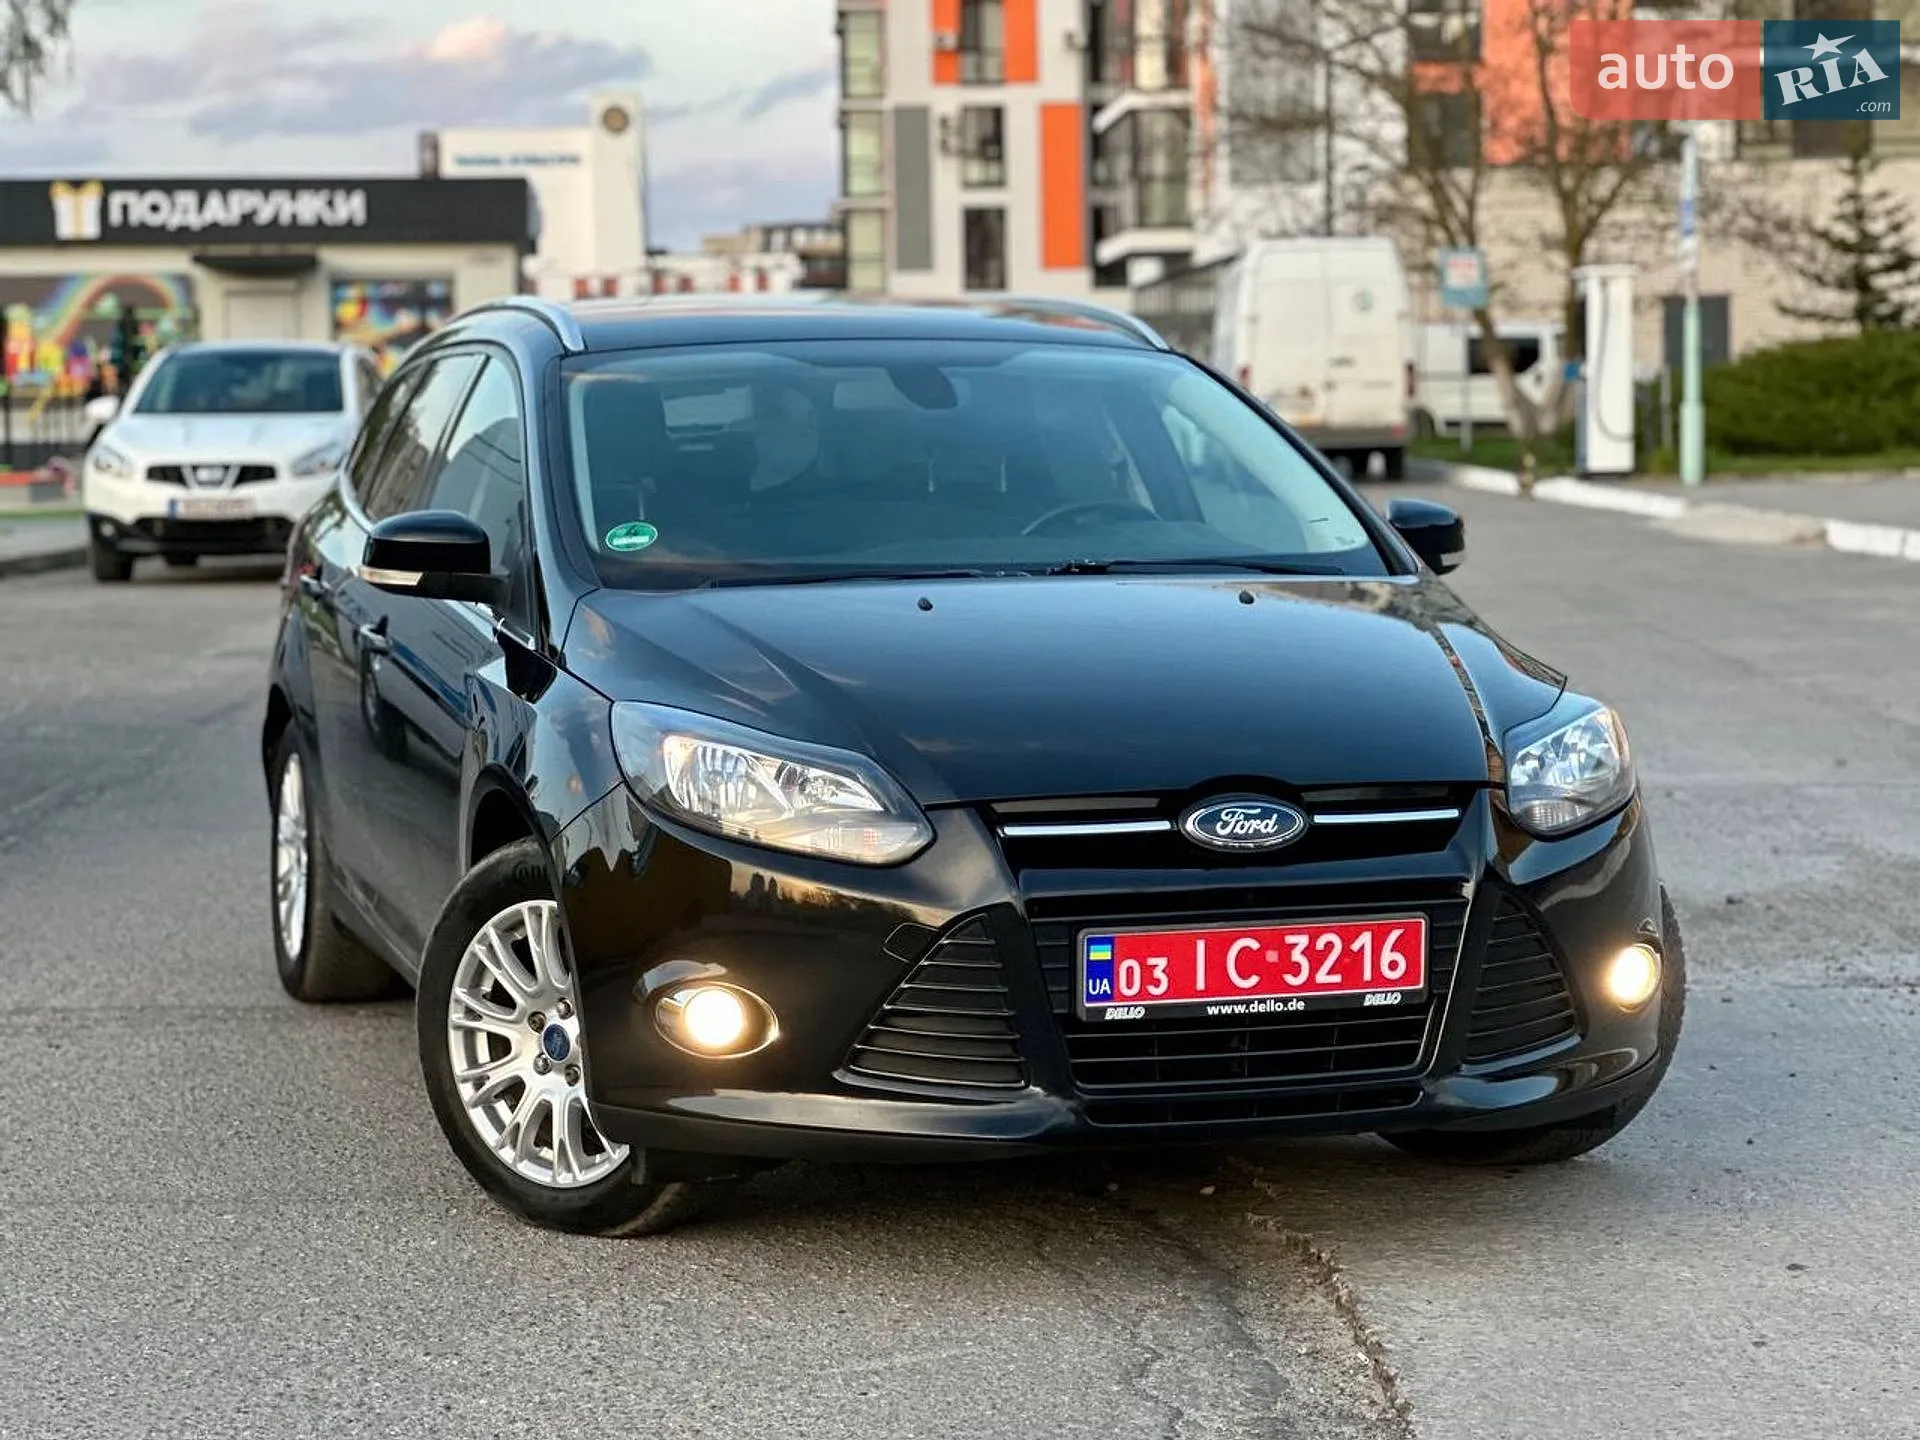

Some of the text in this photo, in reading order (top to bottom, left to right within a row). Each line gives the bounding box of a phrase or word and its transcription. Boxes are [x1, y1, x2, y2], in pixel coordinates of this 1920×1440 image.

[107, 188, 367, 231] ПОДАРУНКИ
[1215, 807, 1279, 836] Ford
[1118, 956, 1169, 997] 03
[1282, 928, 1408, 987] 3216
[1088, 978, 1111, 995] UA
[1206, 998, 1305, 1015] www.dello.de
[1363, 991, 1402, 1006] DELLO
[1104, 1006, 1146, 1020] DELLO
